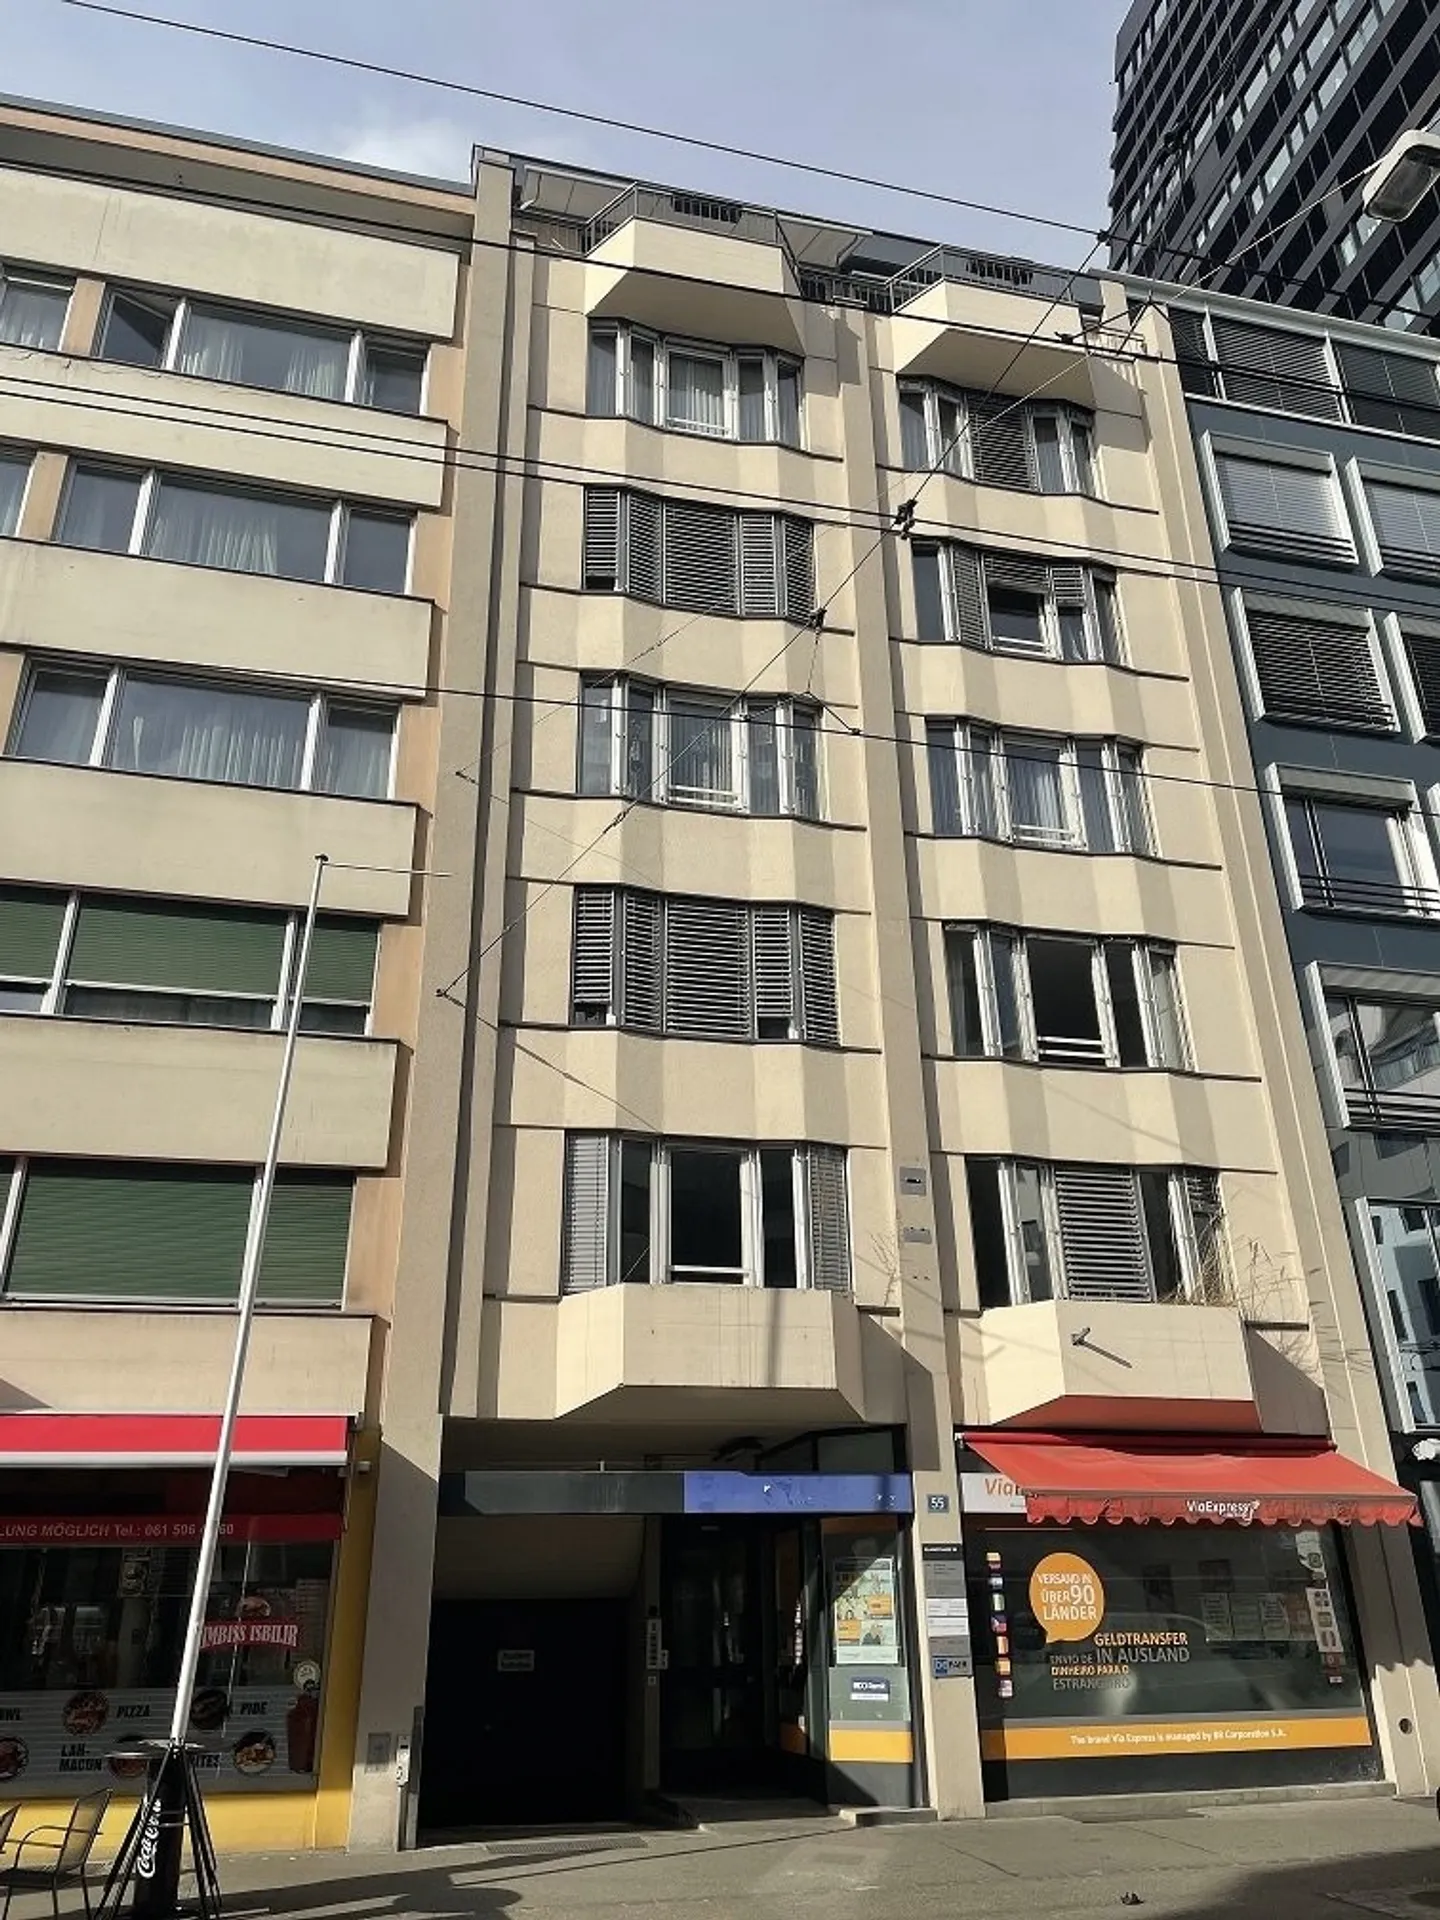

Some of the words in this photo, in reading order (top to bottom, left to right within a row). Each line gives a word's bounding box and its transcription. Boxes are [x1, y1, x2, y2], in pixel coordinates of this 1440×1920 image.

[931, 1497, 945, 1509] 55
[1186, 1500, 1251, 1515] ViaExpress
[41, 1522, 109, 1538] MÖGLICH
[1038, 1572, 1080, 1584] VERSAND
[1041, 1588, 1071, 1603] ÜBER
[1070, 1584, 1095, 1605] 90
[1043, 1604, 1097, 1621] LÄNDER
[200, 1624, 247, 1649] IMBISS
[1094, 1632, 1188, 1646] GELDTRANSFER
[1096, 1648, 1114, 1663] IN
[1117, 1647, 1190, 1663] AUSLAND
[1053, 1677, 1131, 1691] ESTRANGRO
[116, 1704, 151, 1718] PIZZA
[240, 1701, 268, 1715] PIDE
